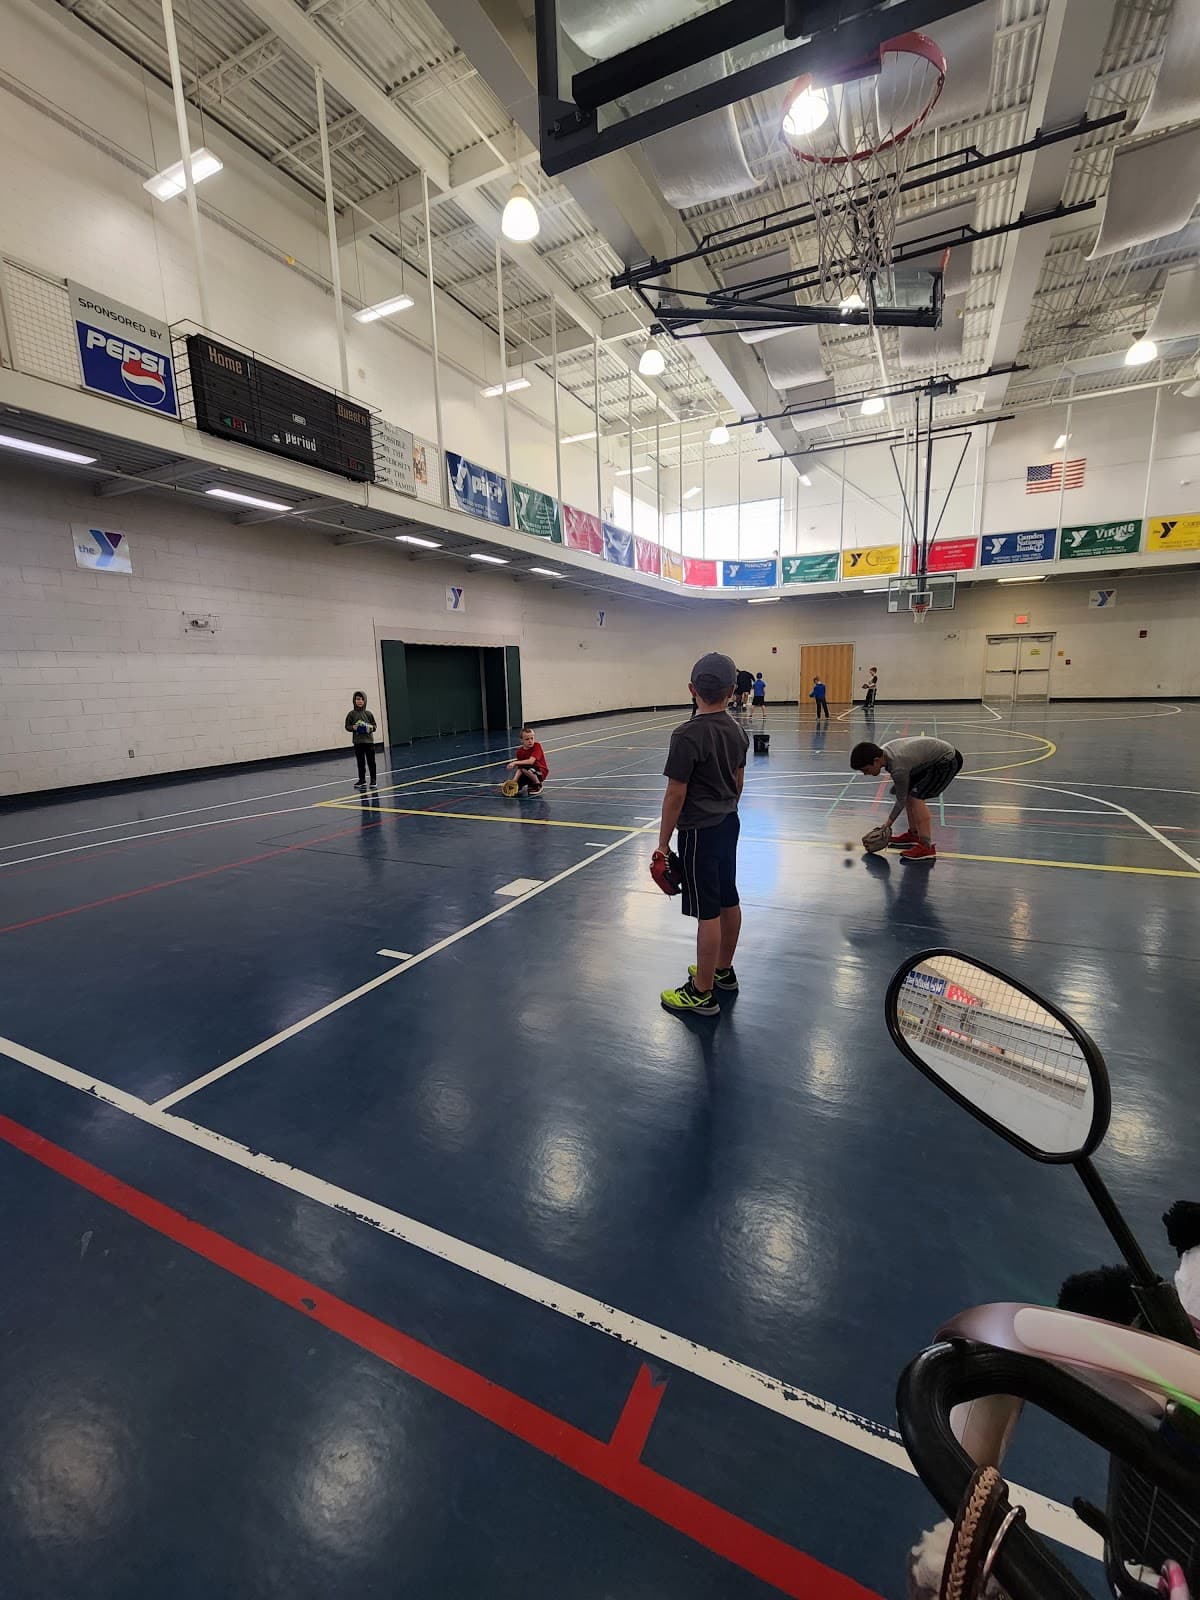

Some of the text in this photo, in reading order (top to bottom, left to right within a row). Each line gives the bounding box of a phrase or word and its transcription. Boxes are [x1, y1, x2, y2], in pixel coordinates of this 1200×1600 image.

[78, 297, 162, 339] SPONSORED BY
[86, 329, 165, 377] PEPSI
[208, 345, 242, 375] Home
[284, 432, 316, 452] period
[79, 545, 96, 555] the
